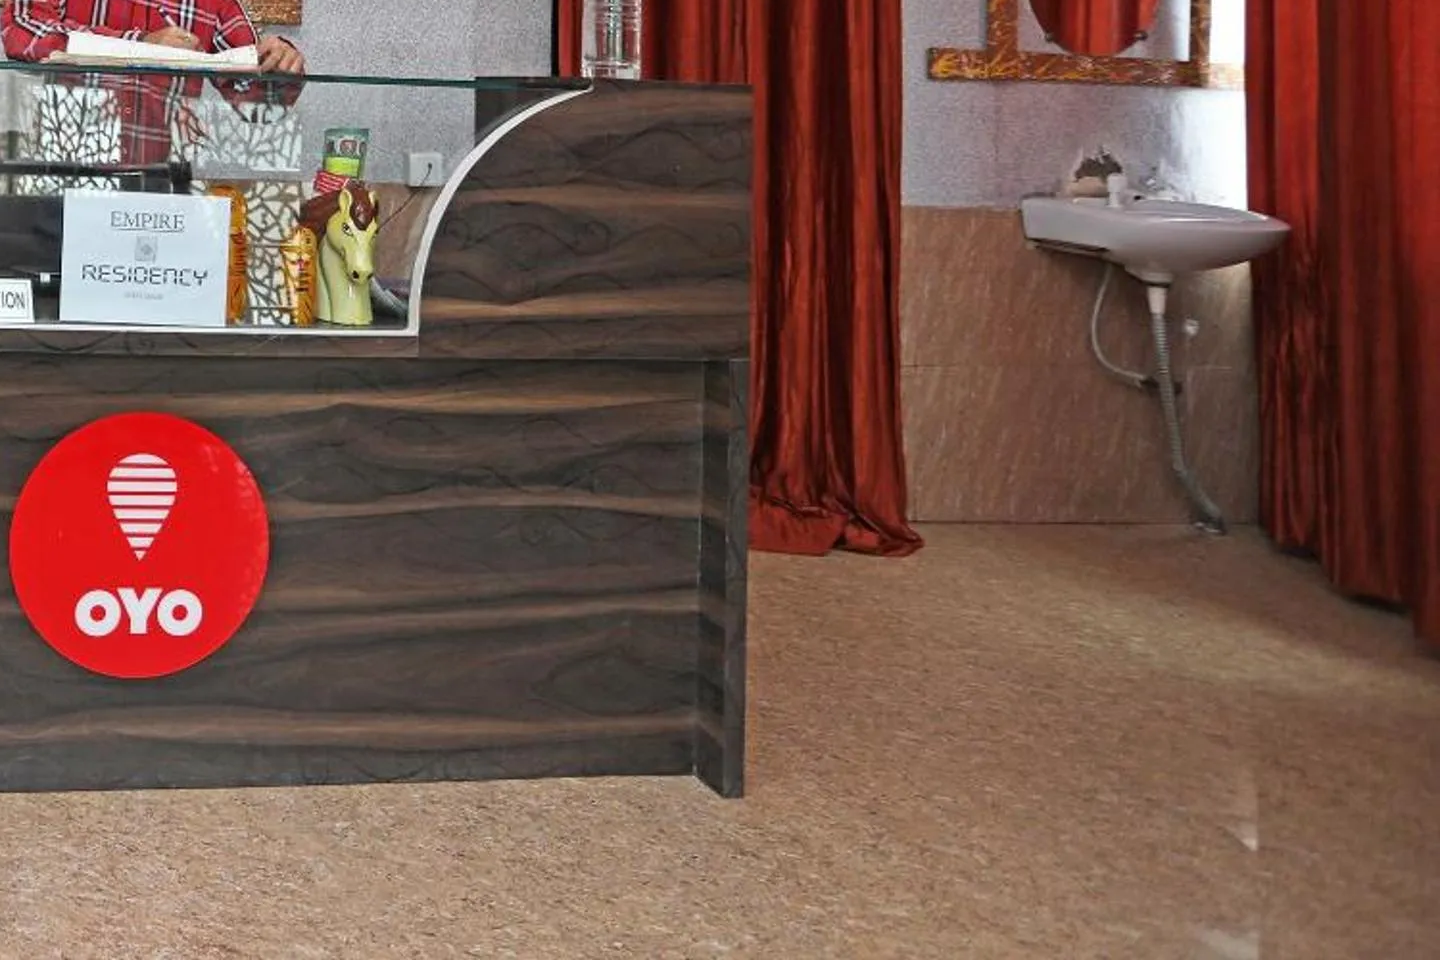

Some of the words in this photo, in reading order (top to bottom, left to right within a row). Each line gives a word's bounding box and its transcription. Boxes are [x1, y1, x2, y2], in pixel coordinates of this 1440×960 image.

[111, 211, 185, 231] EMPIRE
[81, 264, 208, 286] RESIDENCY
[74, 588, 203, 637] OYO
